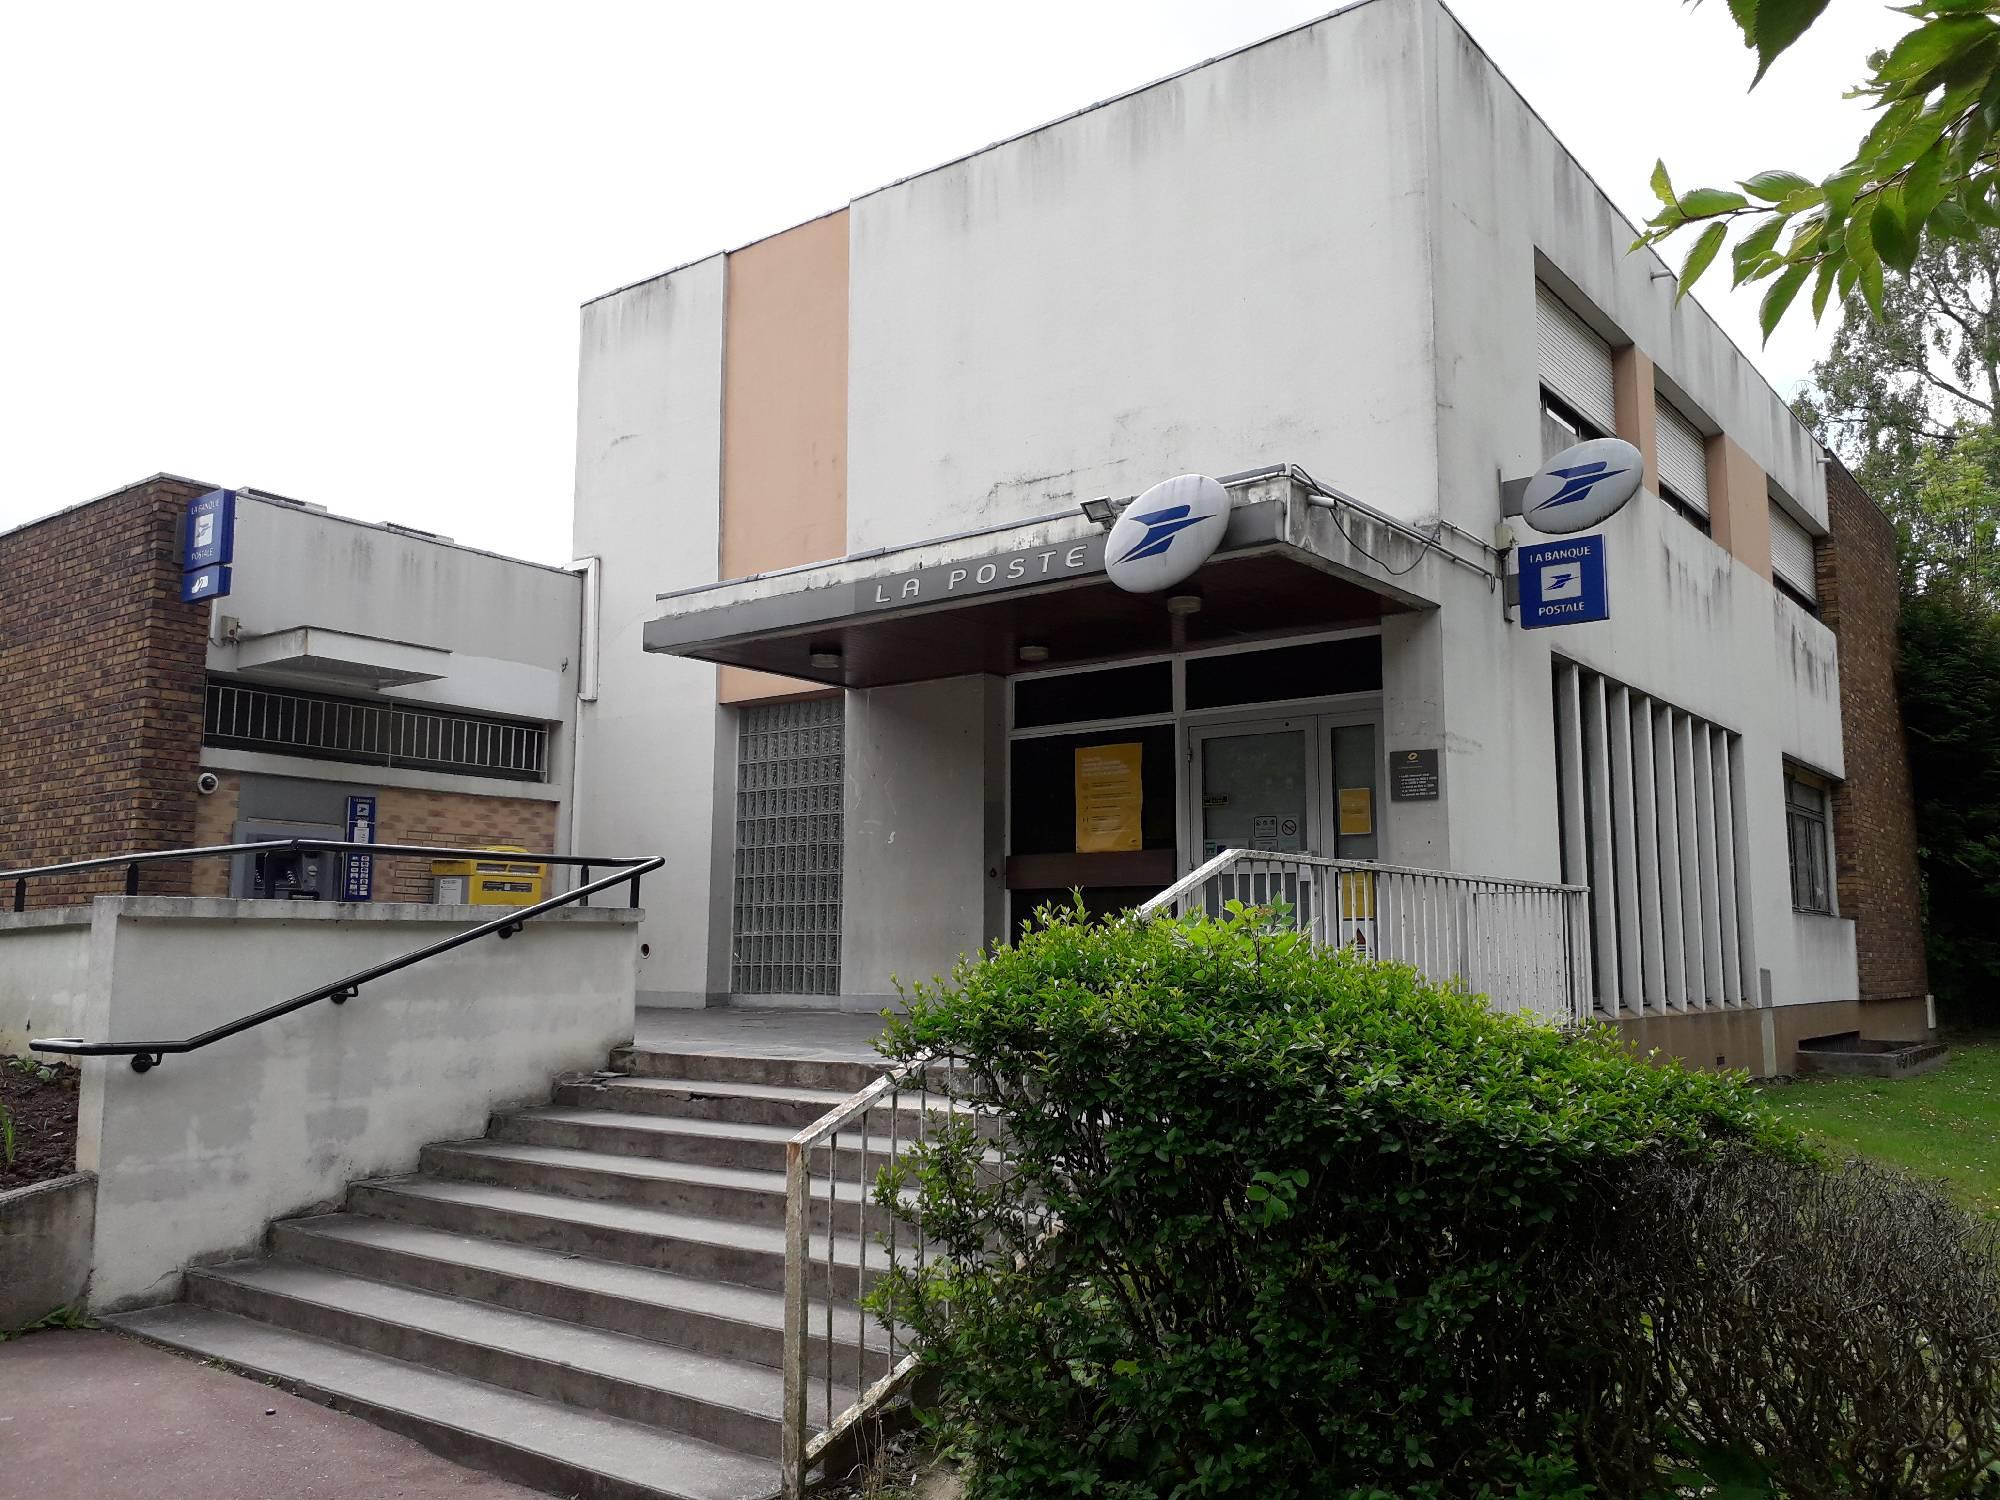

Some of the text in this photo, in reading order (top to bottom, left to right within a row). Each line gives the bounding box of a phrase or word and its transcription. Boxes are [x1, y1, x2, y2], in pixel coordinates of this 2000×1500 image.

[191, 547, 214, 561] POSTALE
[1544, 545, 1592, 561] BANQUE
[874, 543, 1089, 604] LA POSTE
[1538, 601, 1585, 617] POSTALE
